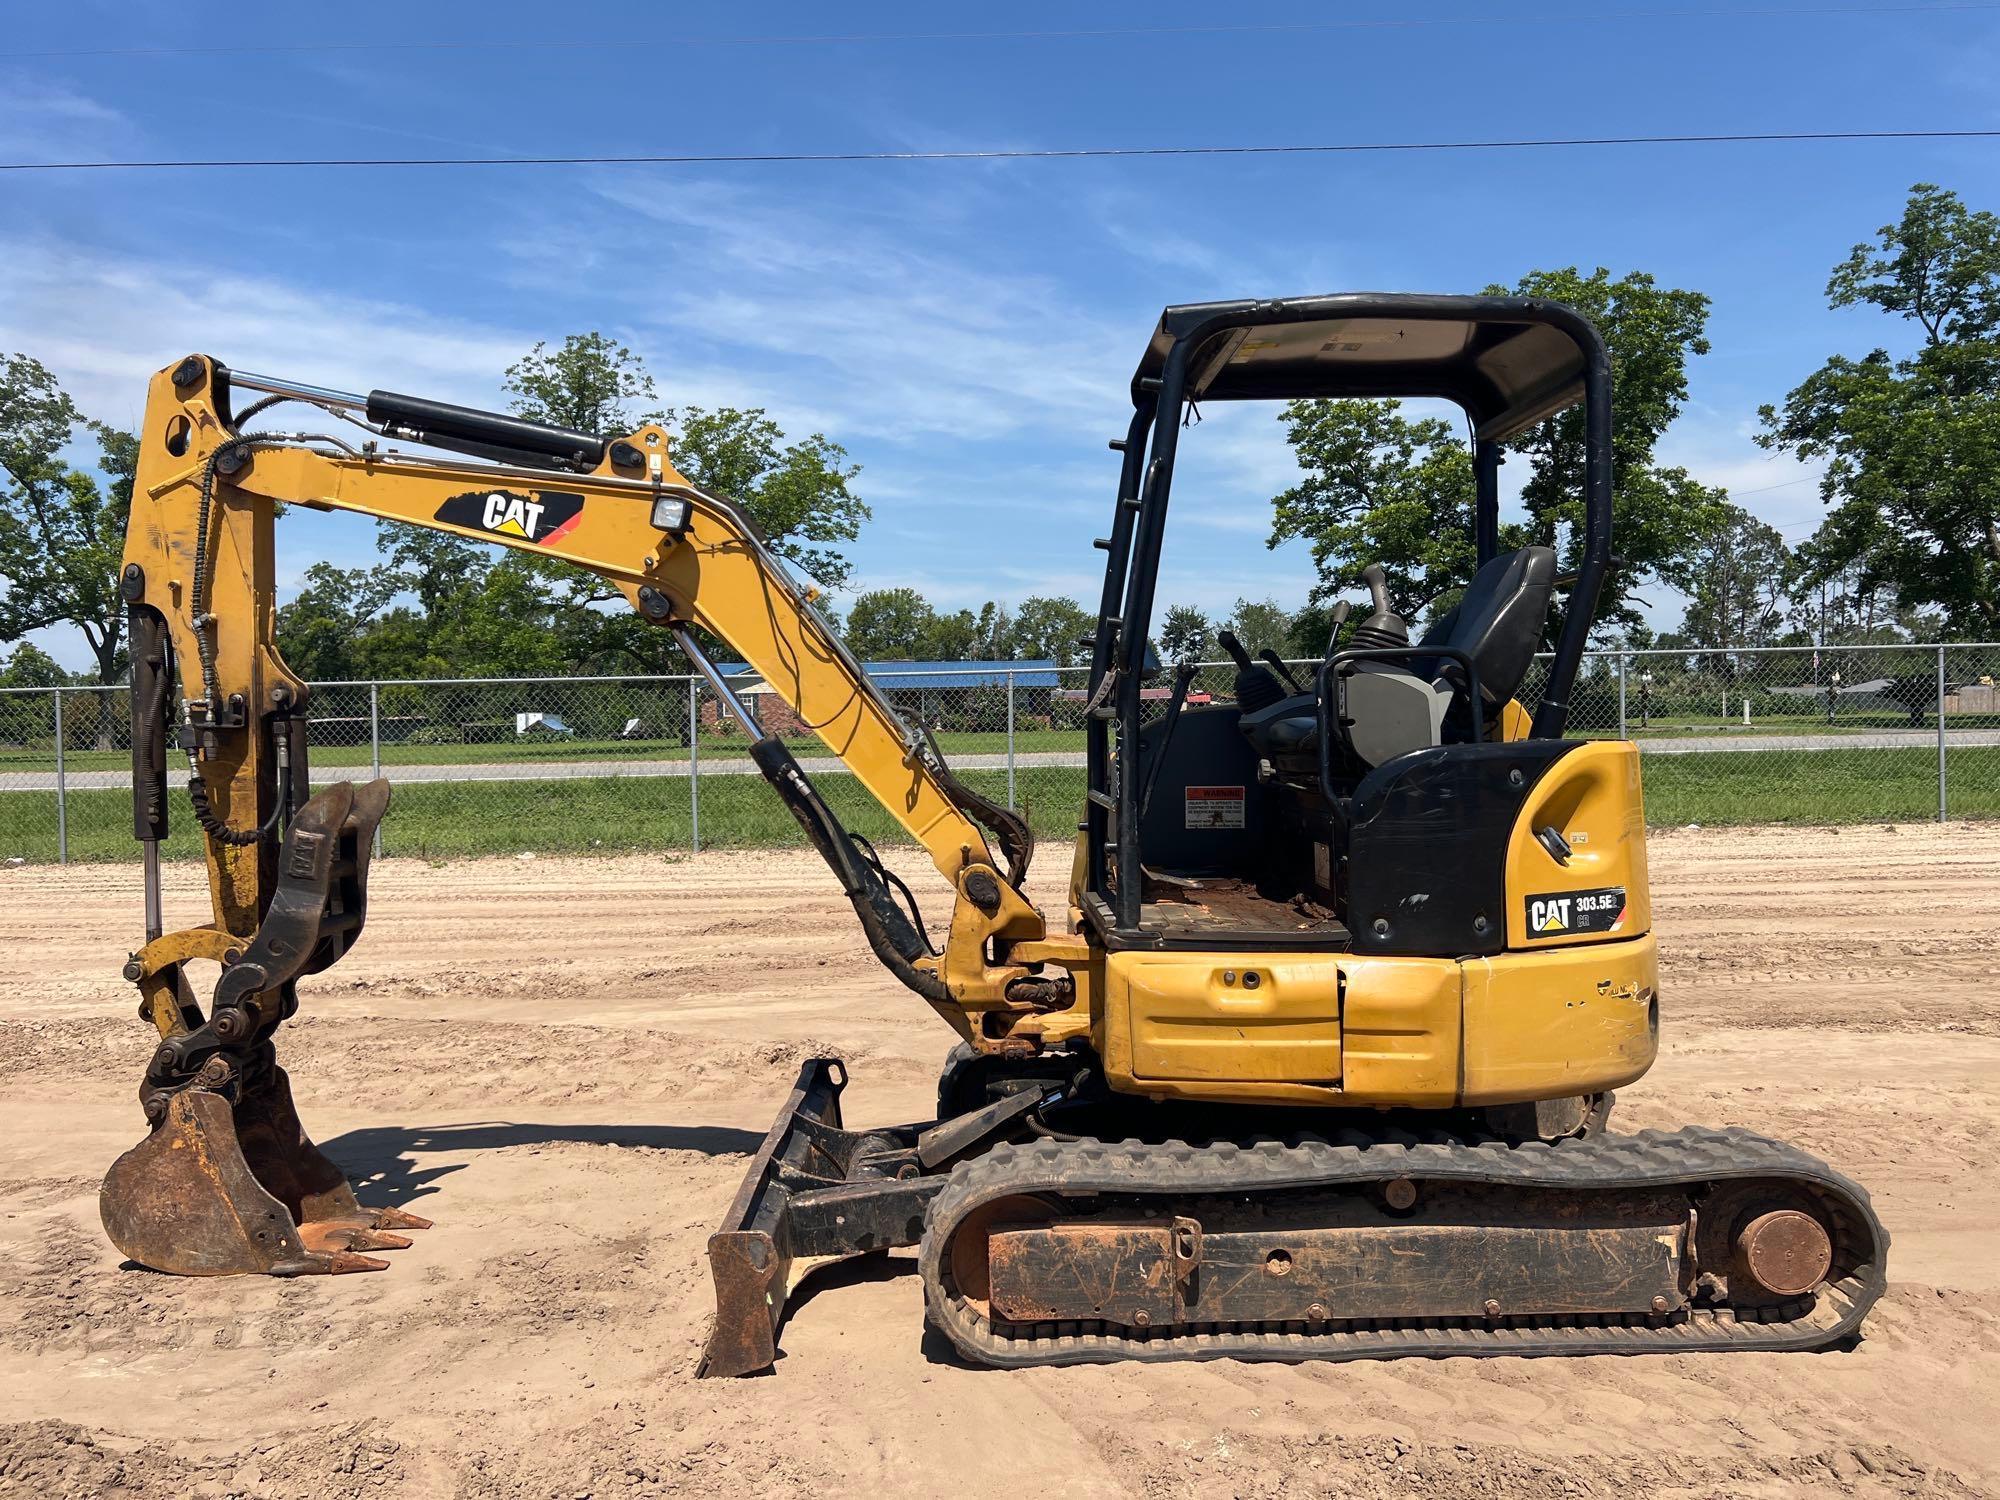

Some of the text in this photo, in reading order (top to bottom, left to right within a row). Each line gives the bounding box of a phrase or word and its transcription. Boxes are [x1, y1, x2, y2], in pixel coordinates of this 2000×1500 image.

[483, 493, 545, 539] CAT
[1203, 789, 1241, 798] WARNING
[1531, 898, 1571, 932] CAT
[1576, 914, 1590, 928] CR
